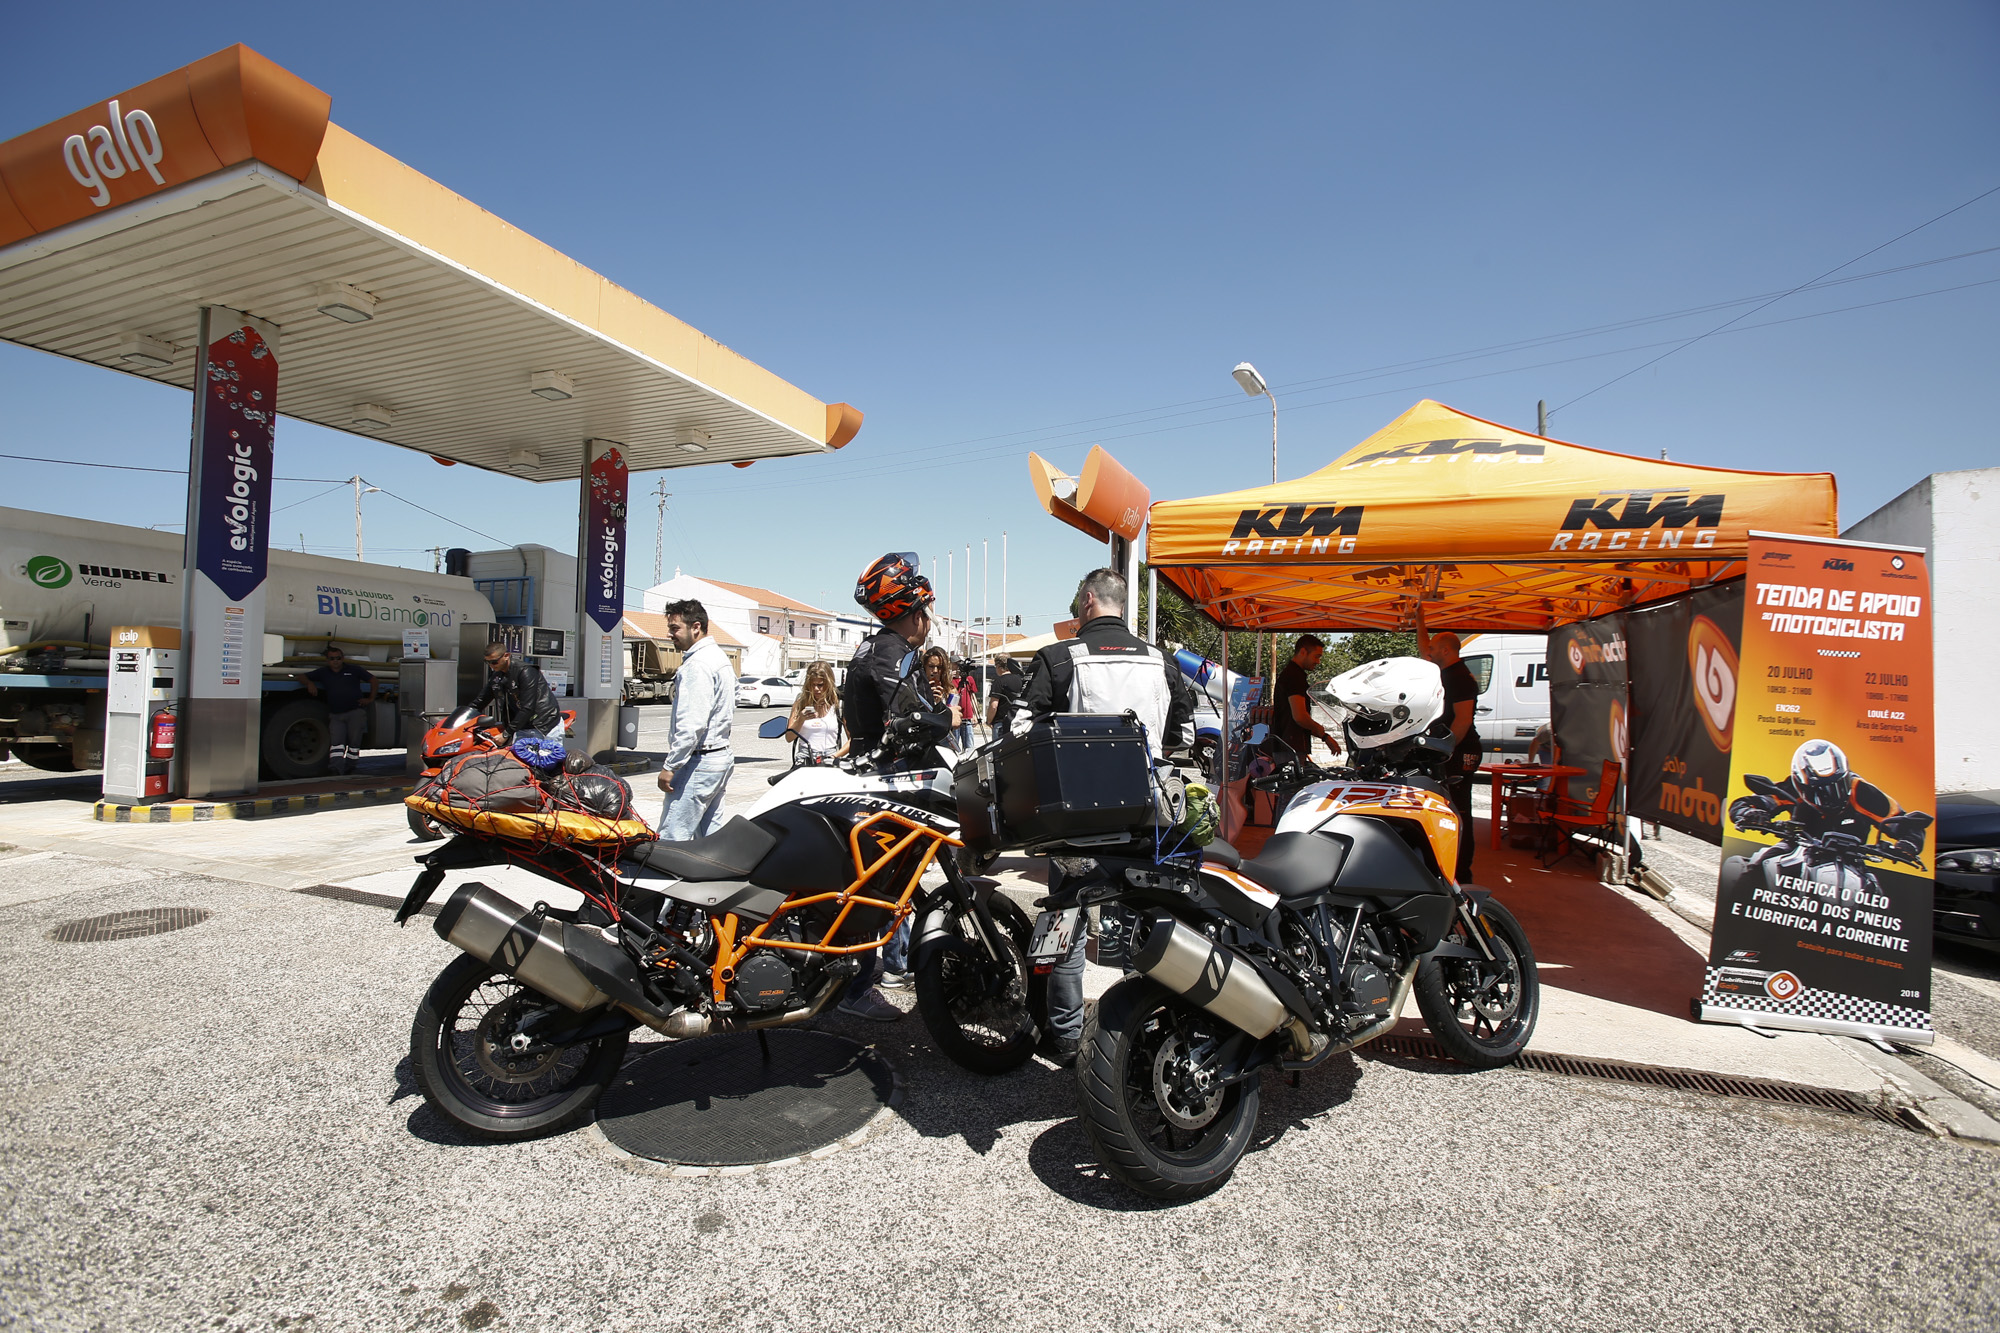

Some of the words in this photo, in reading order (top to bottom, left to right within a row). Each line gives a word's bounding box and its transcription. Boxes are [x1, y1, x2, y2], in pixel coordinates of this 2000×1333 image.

[63, 99, 166, 207] galp
[1346, 438, 1546, 466] KTM
[223, 442, 259, 551] evologic
[616, 504, 626, 518] 04
[1560, 487, 1726, 530] KTM
[1120, 506, 1141, 533] galp
[1230, 501, 1365, 538] KTM
[599, 526, 619, 600] evologic
[1822, 557, 1855, 572] KTM
[79, 563, 174, 585] HUBEL
[81, 576, 122, 589] Verde
[316, 585, 354, 596] ADUBOS
[354, 588, 395, 601] LÍQUIDOS
[1755, 583, 1825, 610] TENDA
[1827, 590, 1857, 612] DE
[1859, 592, 1922, 617] APOIO
[119, 629, 139, 645] galp
[1770, 613, 1906, 642] MOTOCICLISTA
[1767, 665, 1780, 678] 20
[1782, 666, 1813, 680] JULHO
[1865, 672, 1877, 685] 22
[1879, 673, 1909, 687] JULHO
[1775, 703, 1801, 713] EN262
[1867, 709, 1890, 719] LOULÉ
[1890, 712, 1906, 720] A22
[1757, 714, 1776, 723] Posto
[1777, 716, 1792, 725] Galp
[1768, 728, 1793, 737] sentido
[1662, 754, 1687, 779] Galp
[1774, 873, 1837, 899] VERIFICA
[1840, 888, 1851, 902] O
[1855, 888, 1890, 910] ÓLEO
[1752, 888, 1818, 914] PRESSÃO
[1821, 903, 1850, 921] DOS
[1853, 909, 1902, 932] PNEUS
[1047, 912, 1064, 933] 62
[1731, 902, 1742, 916] E
[1744, 904, 1818, 933] LUBRIFICA
[1820, 922, 1832, 936] A
[1835, 925, 1910, 953] CORRENTE
[1719, 982, 1740, 991] Galp
[1720, 976, 1764, 986] Lubrificantes
[1900, 989, 1920, 998] 2018
